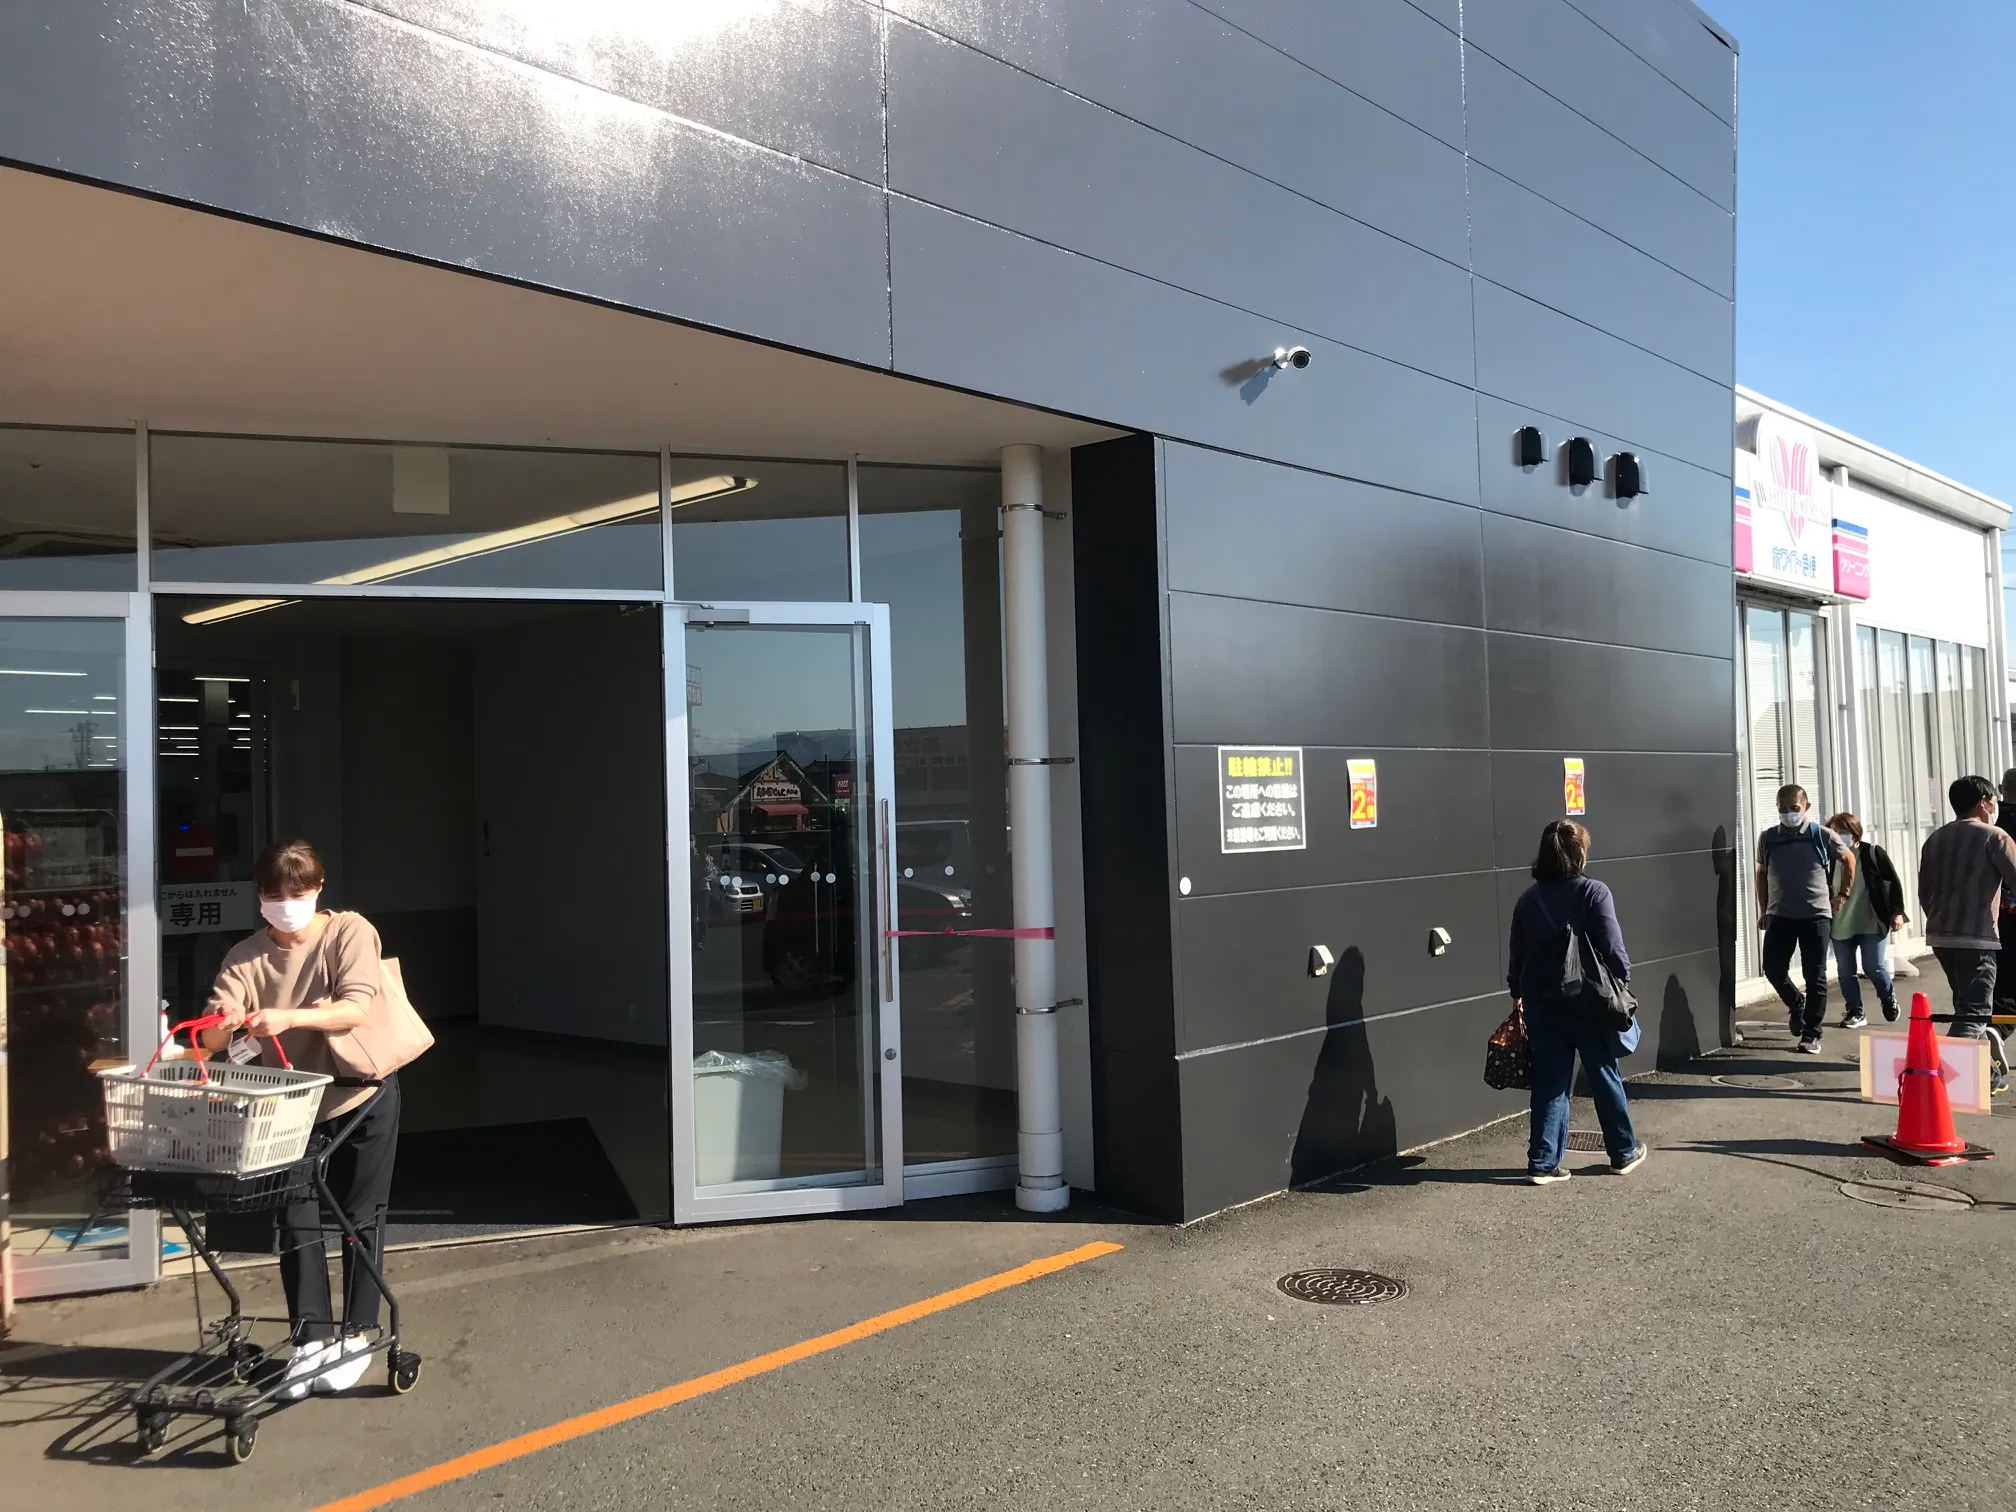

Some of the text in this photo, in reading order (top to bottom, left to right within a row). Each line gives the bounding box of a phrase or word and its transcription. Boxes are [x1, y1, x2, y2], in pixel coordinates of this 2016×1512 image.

[1772, 546, 1817, 579] ホワイト急便
[1840, 557, 1869, 578] クリーニング
[170, 902, 221, 927] 専用
